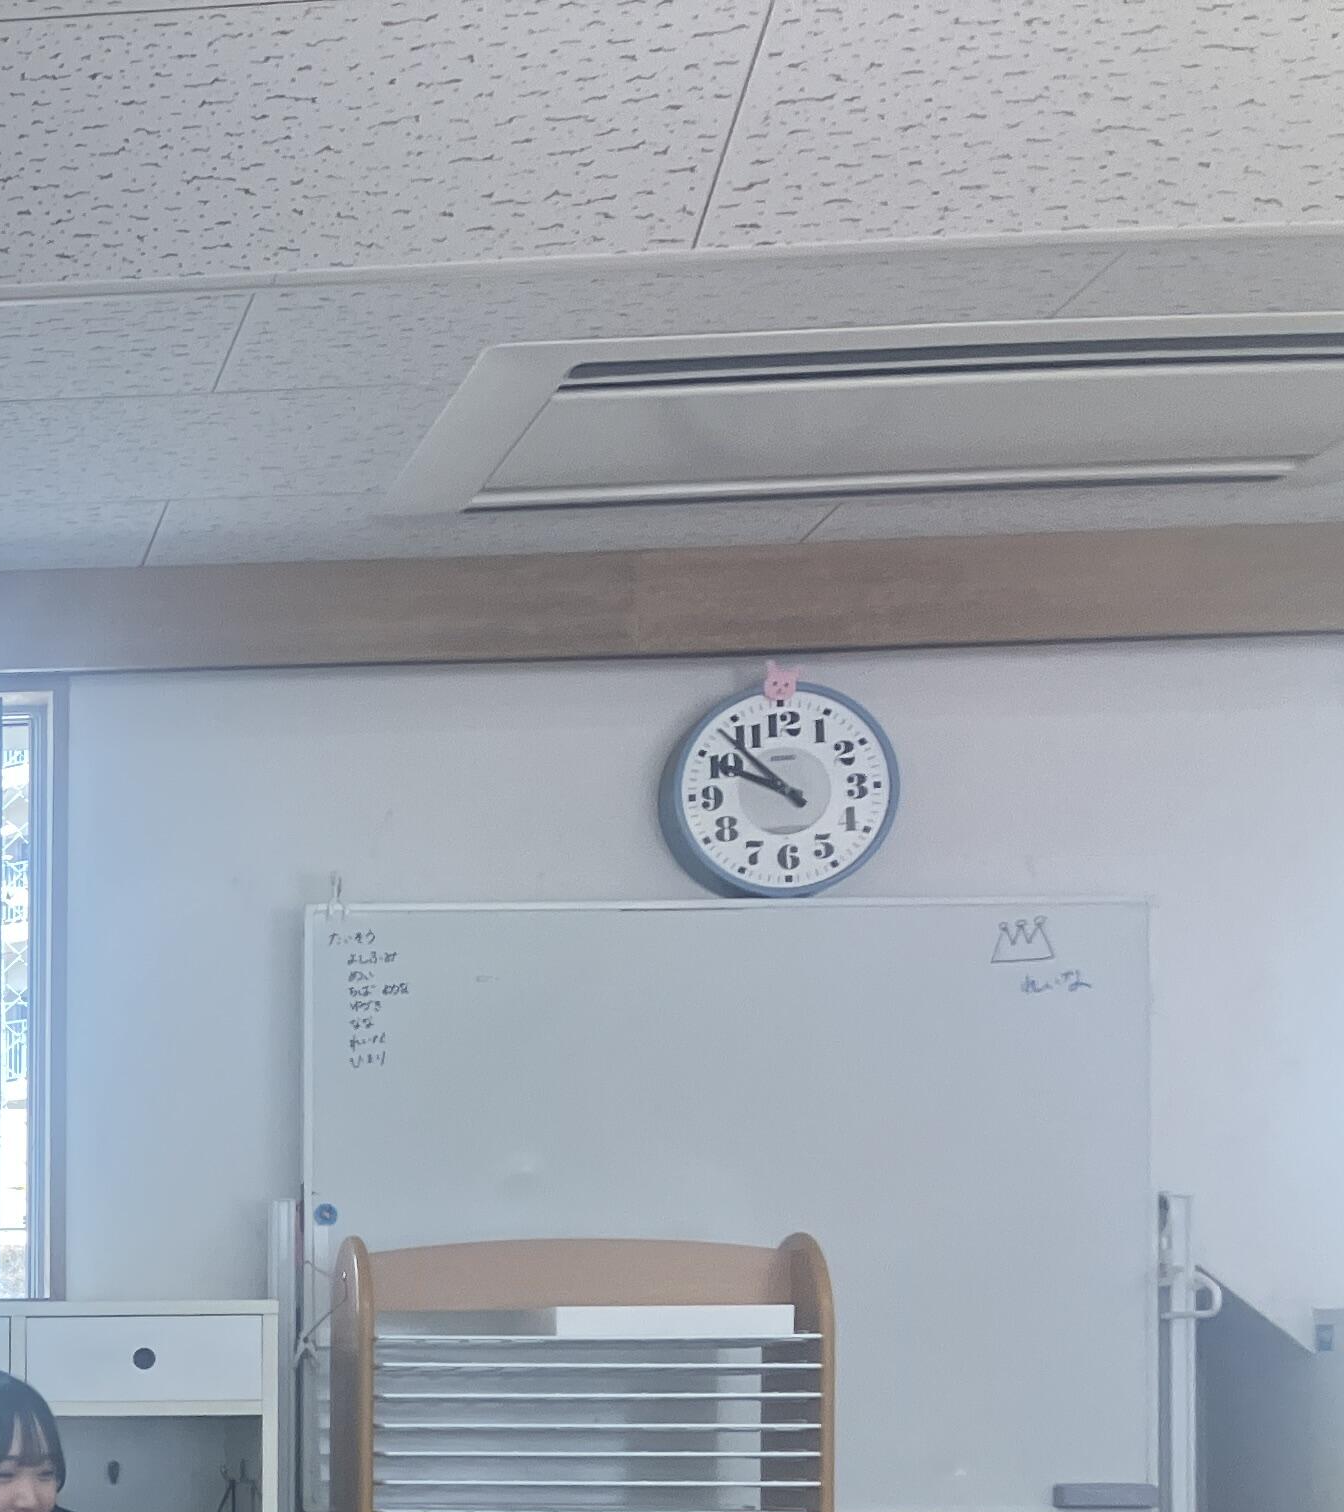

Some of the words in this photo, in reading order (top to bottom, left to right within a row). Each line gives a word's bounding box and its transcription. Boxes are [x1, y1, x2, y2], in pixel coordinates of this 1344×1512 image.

[734, 724, 761, 750] 11
[768, 711, 801, 737] 12
[814, 718, 826, 744] 1
[709, 753, 743, 779] 10
[834, 740, 855, 766] 2
[702, 785, 724, 811] 9
[847, 773, 868, 799] 3
[715, 816, 739, 842] 8
[838, 806, 859, 832] 4
[745, 840, 764, 865] 7
[777, 844, 800, 870] 6
[814, 833, 835, 859] 5
